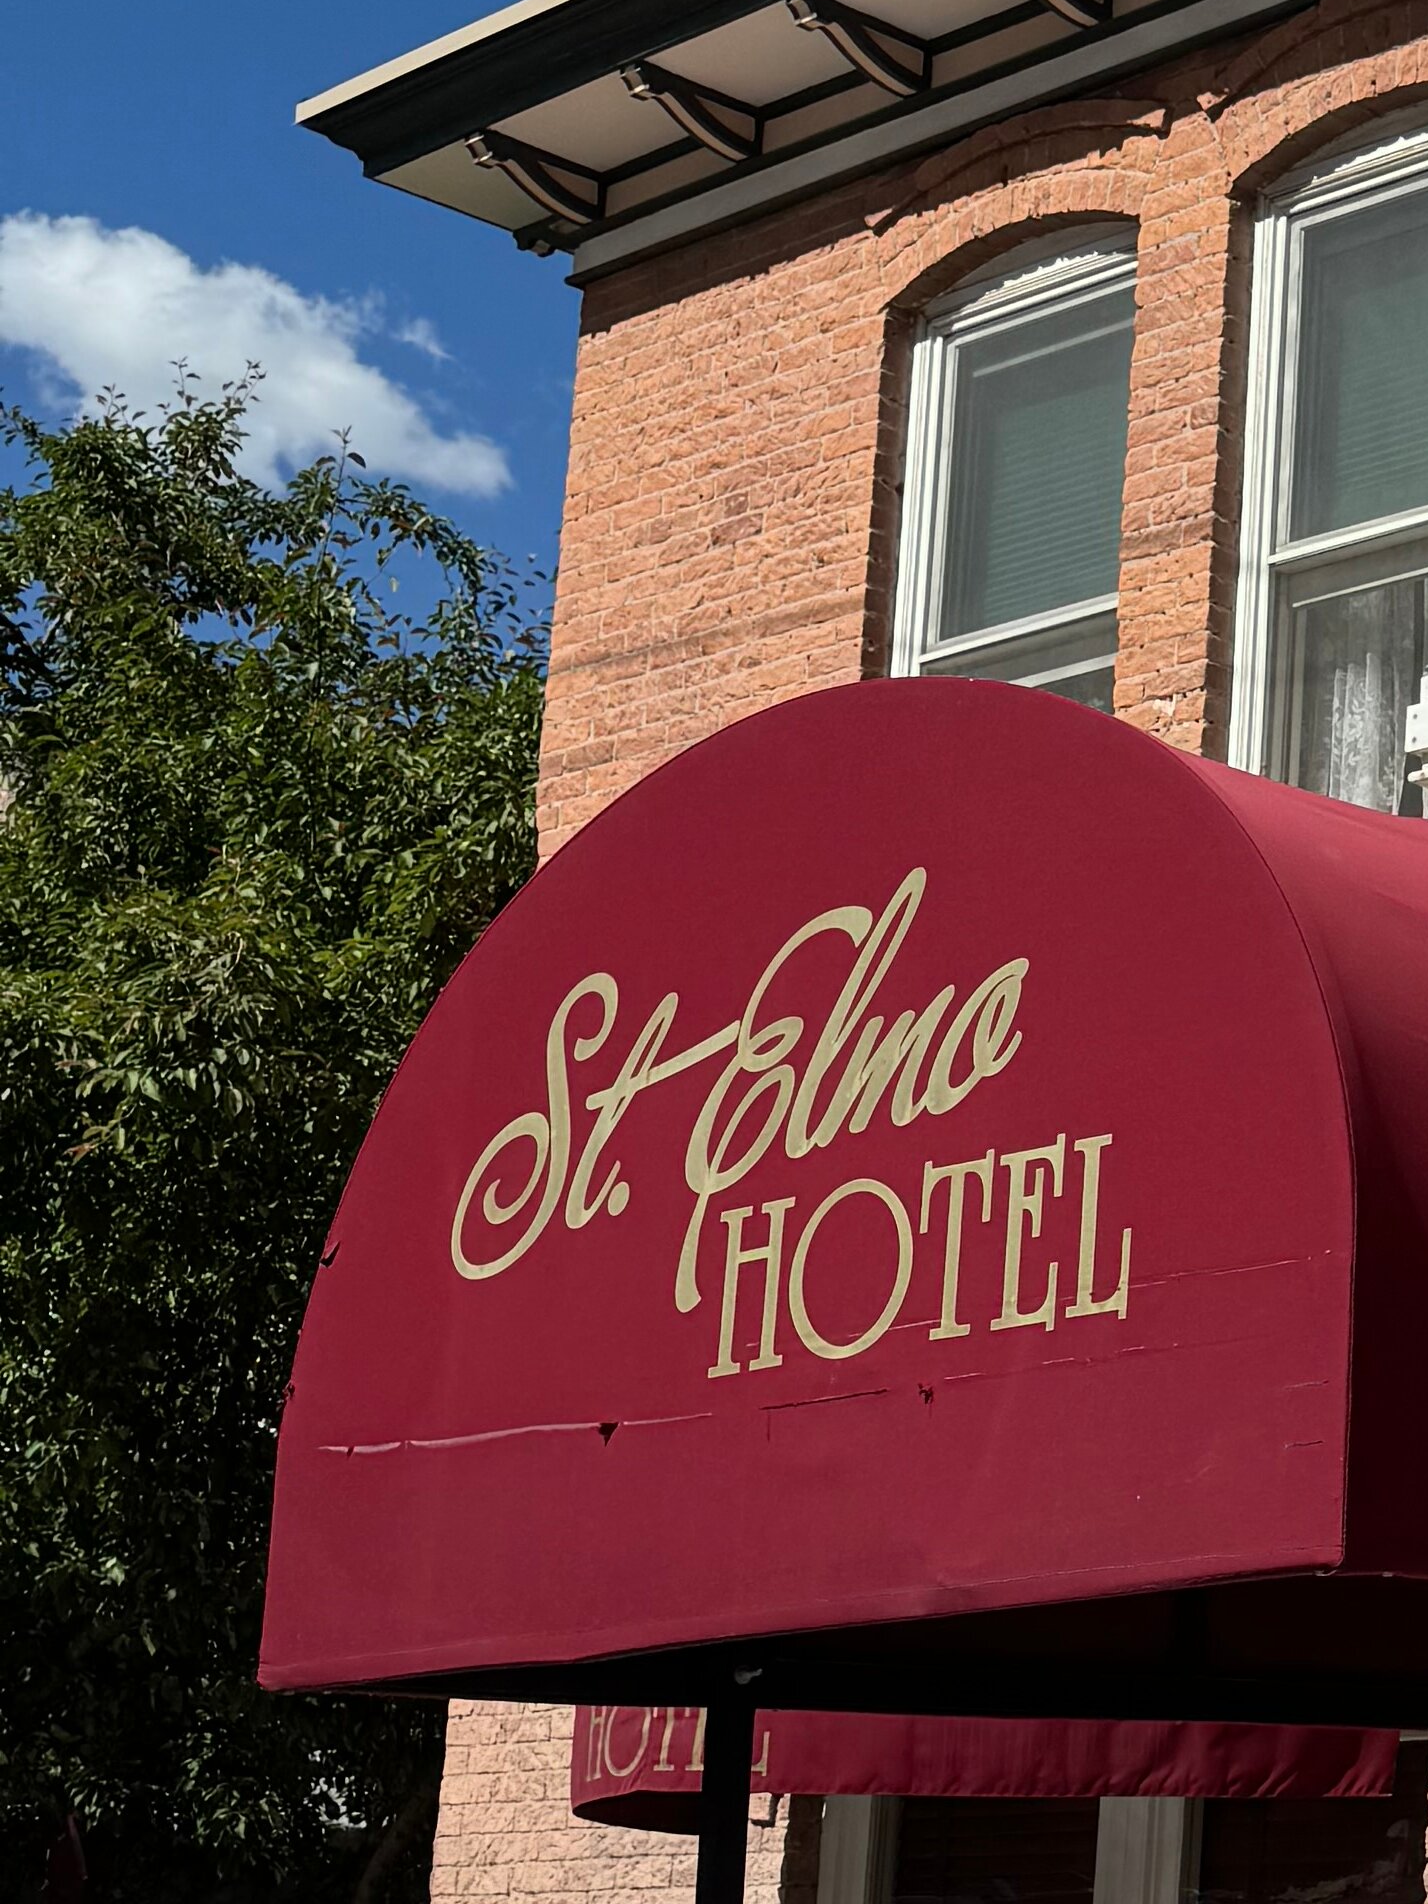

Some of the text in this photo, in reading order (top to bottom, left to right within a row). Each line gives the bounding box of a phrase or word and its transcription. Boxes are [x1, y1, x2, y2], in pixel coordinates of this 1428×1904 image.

[451, 866, 1029, 1313] St. Elmo
[707, 1132, 1133, 1379] HOTEL
